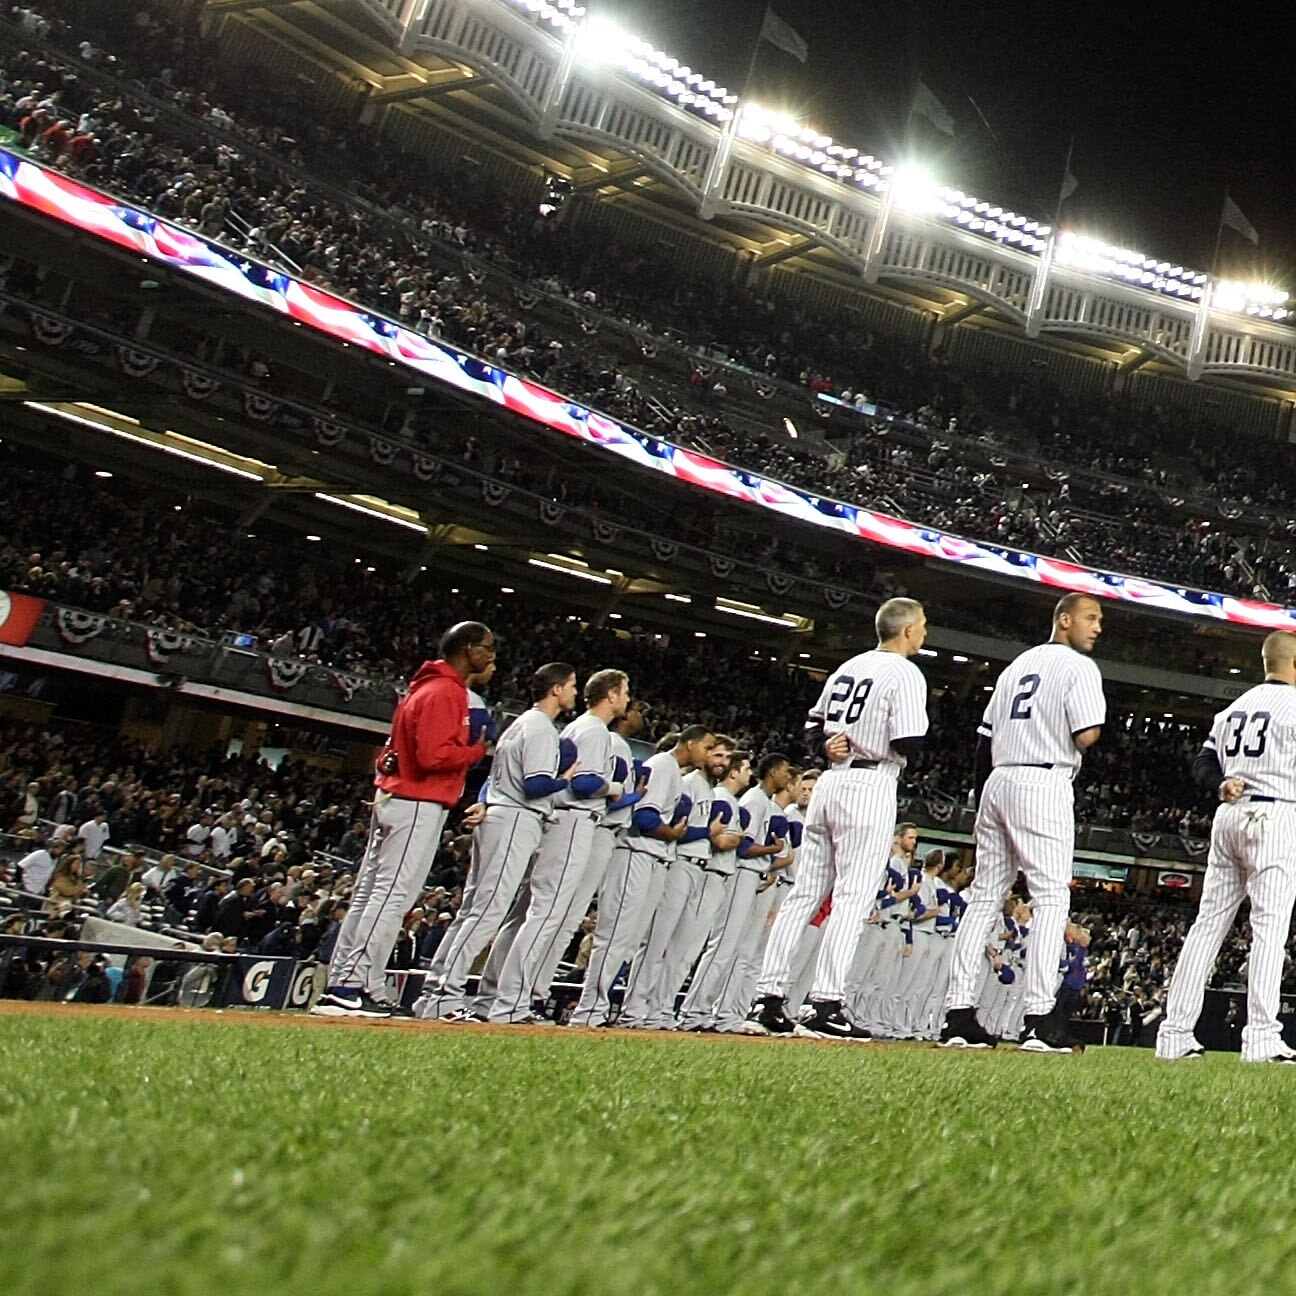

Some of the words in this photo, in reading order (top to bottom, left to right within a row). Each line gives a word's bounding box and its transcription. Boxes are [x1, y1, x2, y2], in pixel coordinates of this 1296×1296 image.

[826, 675, 873, 724] 28
[1010, 673, 1041, 720] 2
[1225, 711, 1271, 757] 33
[243, 961, 277, 1003] G
